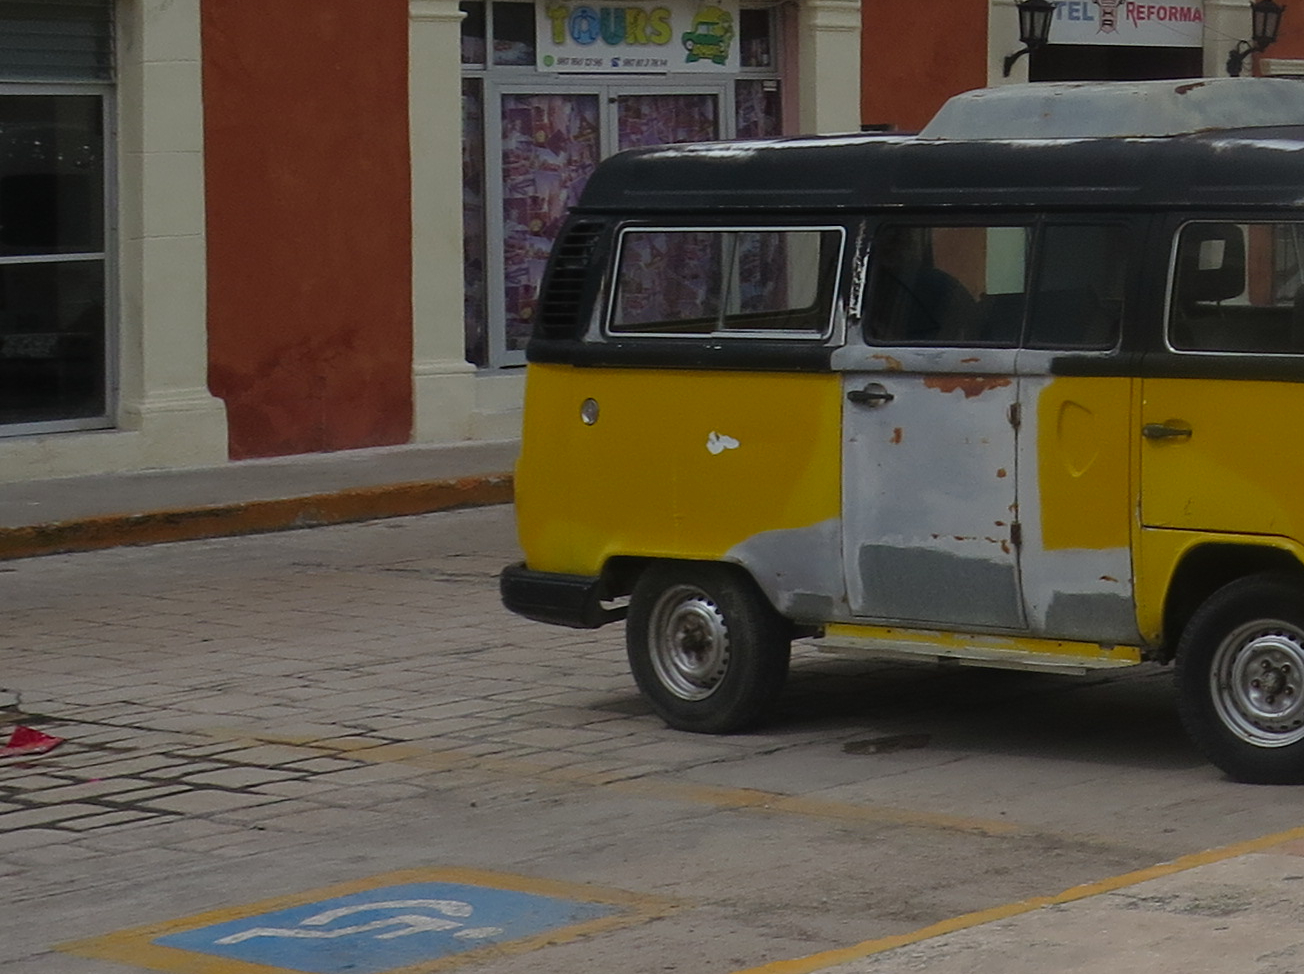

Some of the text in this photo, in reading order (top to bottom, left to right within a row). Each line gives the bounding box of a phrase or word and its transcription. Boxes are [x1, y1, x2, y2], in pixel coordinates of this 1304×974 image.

[547, 5, 673, 45] TOURS
[1054, 0, 1204, 28] TEL REFORMA
